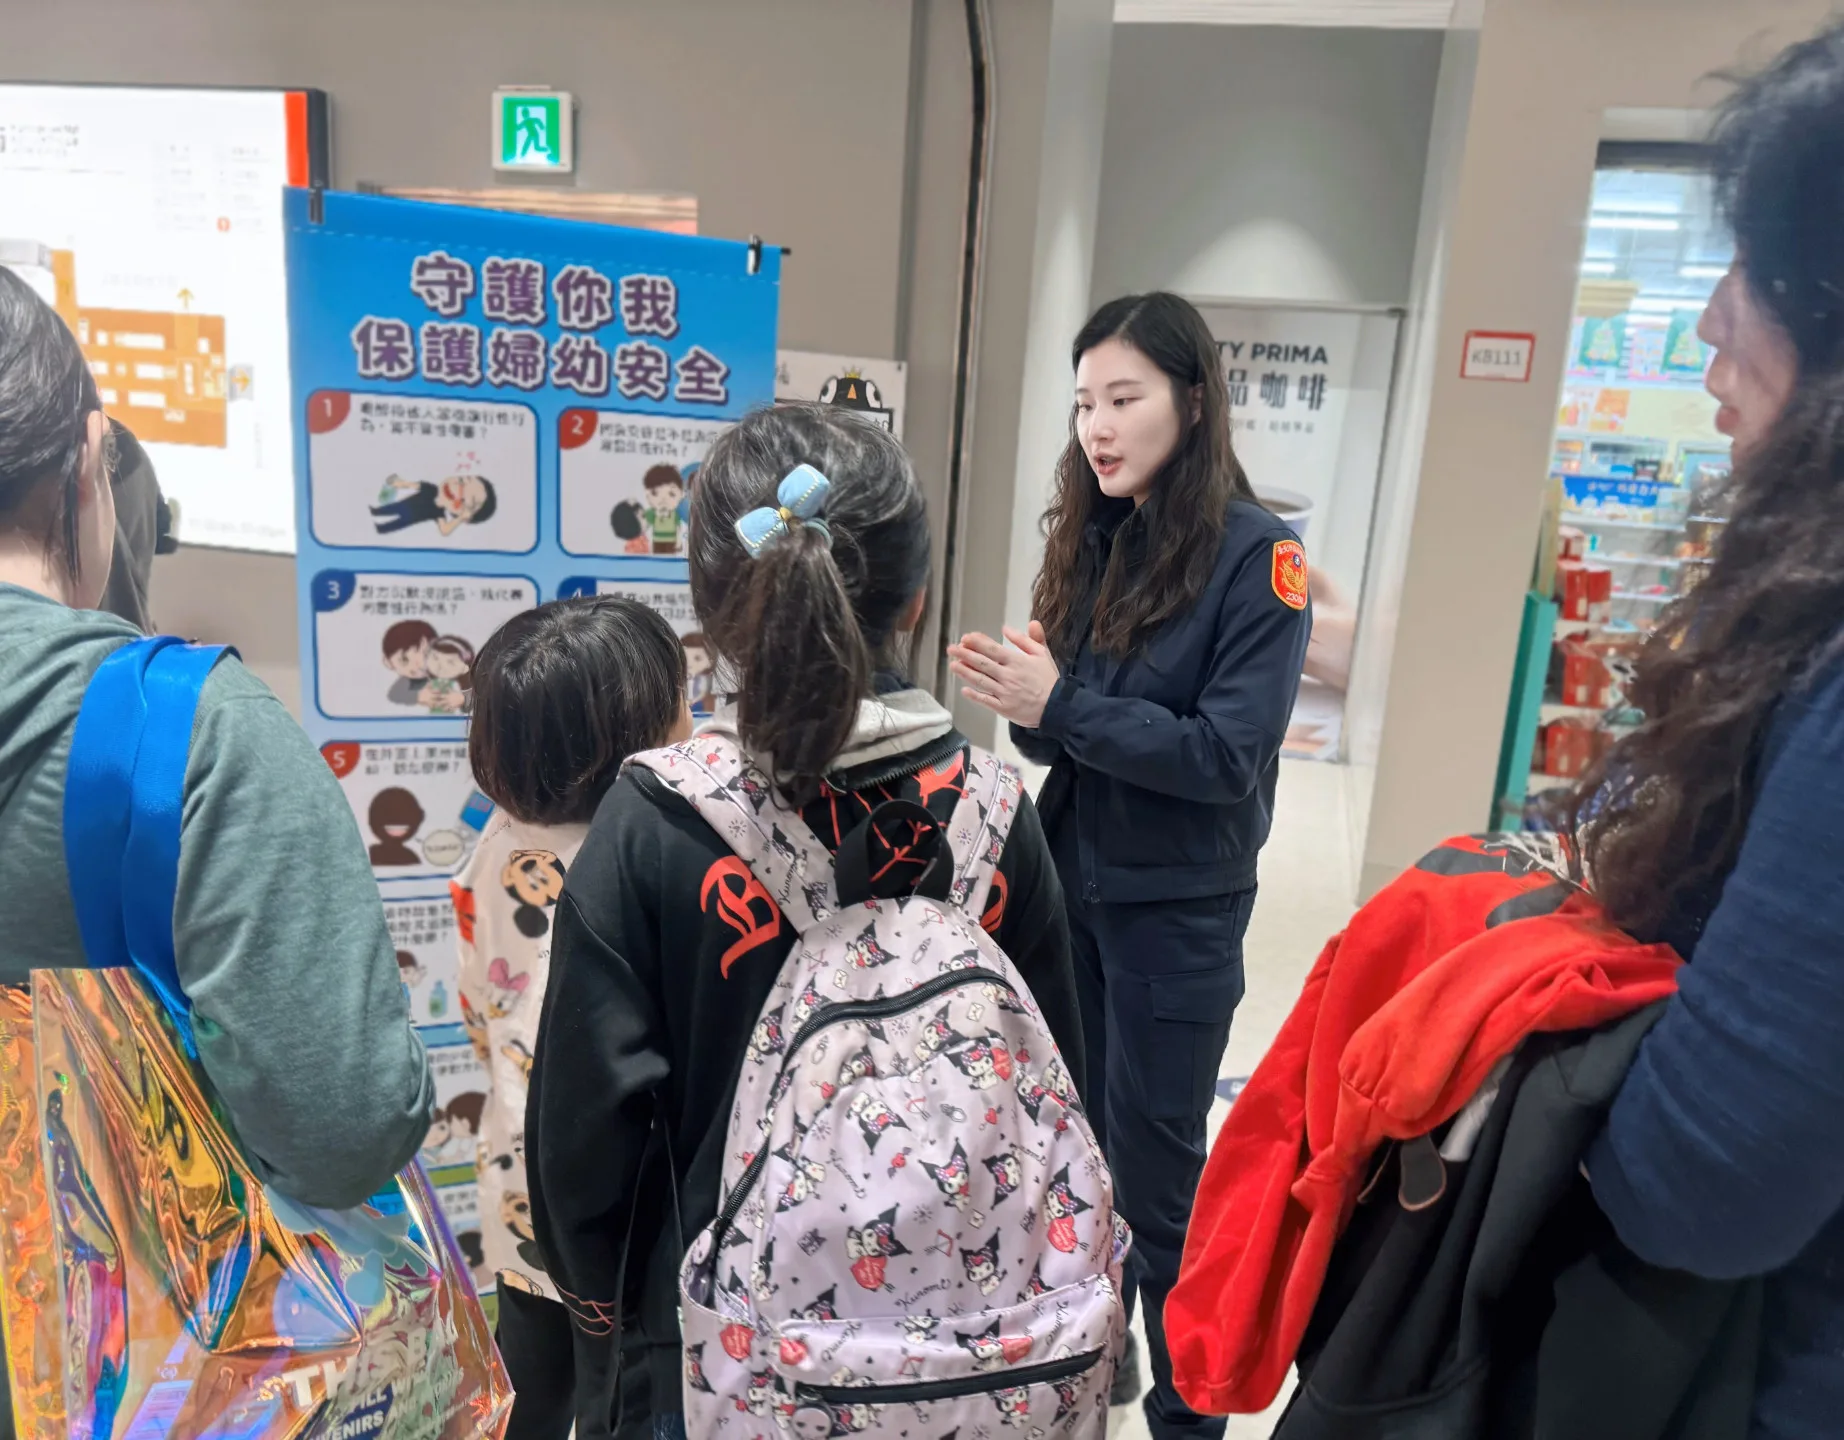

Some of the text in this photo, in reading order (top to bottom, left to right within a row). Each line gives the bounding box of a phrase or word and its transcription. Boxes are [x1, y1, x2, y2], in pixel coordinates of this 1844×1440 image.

[410, 253, 681, 338] 守護你我
[352, 317, 731, 404] 保護婦幼安全
[1251, 342, 1329, 365] PRIMA
[322, 398, 333, 419] 1
[571, 414, 585, 436] 2
[326, 580, 341, 600] 3
[332, 749, 346, 769] 5
